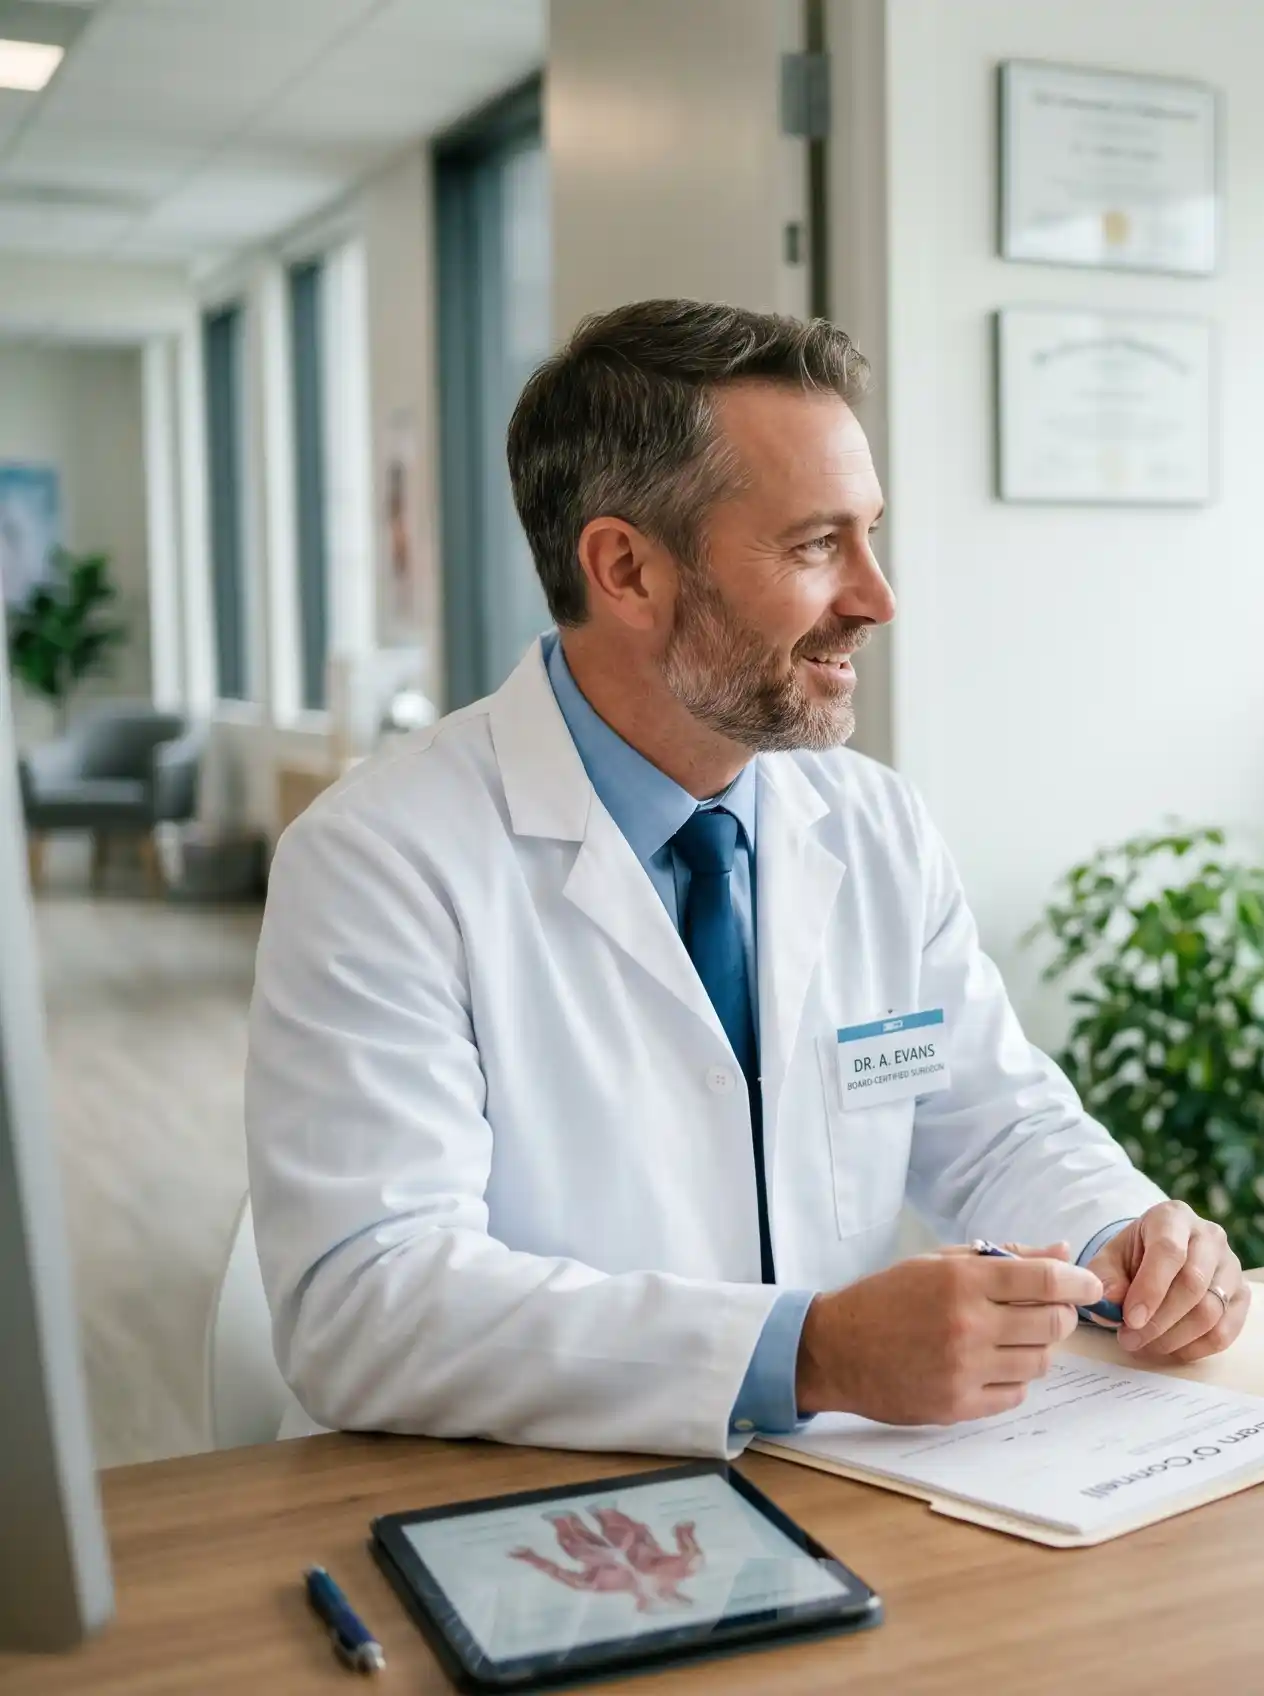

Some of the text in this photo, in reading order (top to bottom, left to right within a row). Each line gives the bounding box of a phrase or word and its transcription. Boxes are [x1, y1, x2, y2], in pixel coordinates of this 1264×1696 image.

[854, 1043, 935, 1073] DR. A. EVANS
